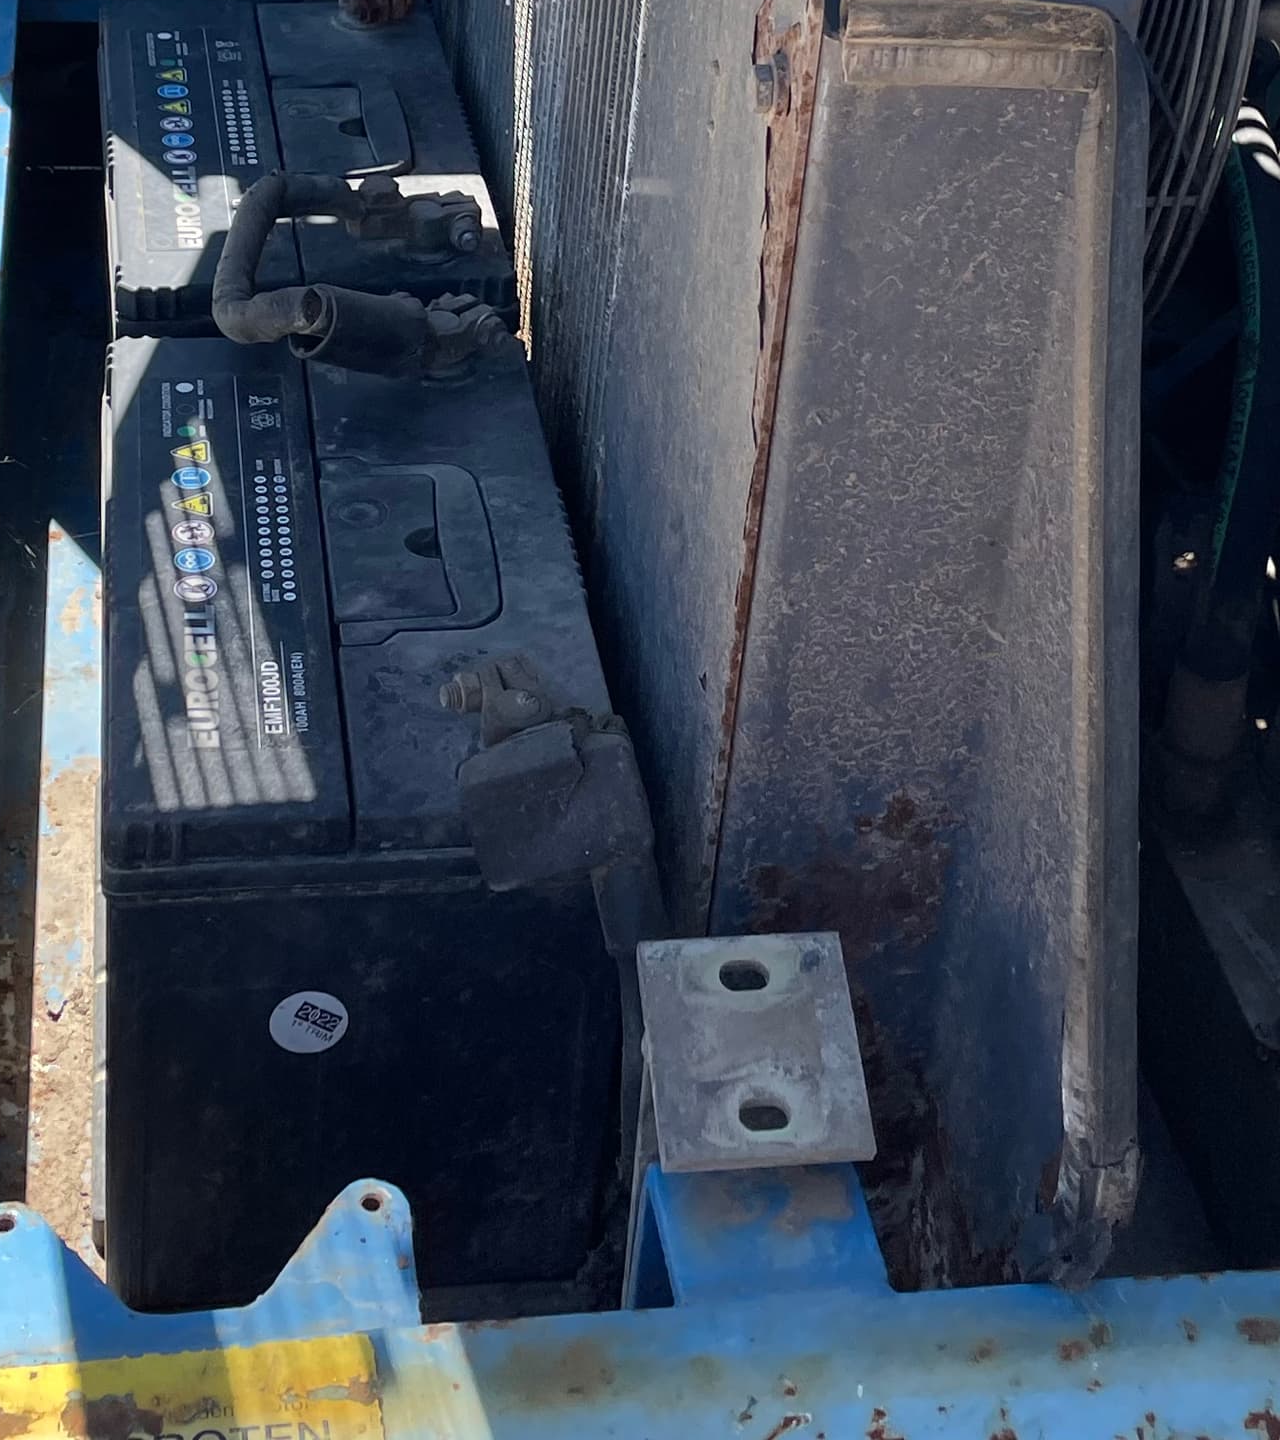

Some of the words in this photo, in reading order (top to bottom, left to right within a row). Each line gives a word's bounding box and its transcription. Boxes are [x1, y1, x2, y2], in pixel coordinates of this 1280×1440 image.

[171, 165, 204, 249] EUROCELL
[183, 605, 220, 749] EUROCELL
[260, 660, 283, 735] EMF100JD
[291, 652, 307, 697] 800A(EN)
[294, 701, 309, 733] 100AH
[297, 1004, 340, 1031] 2022
